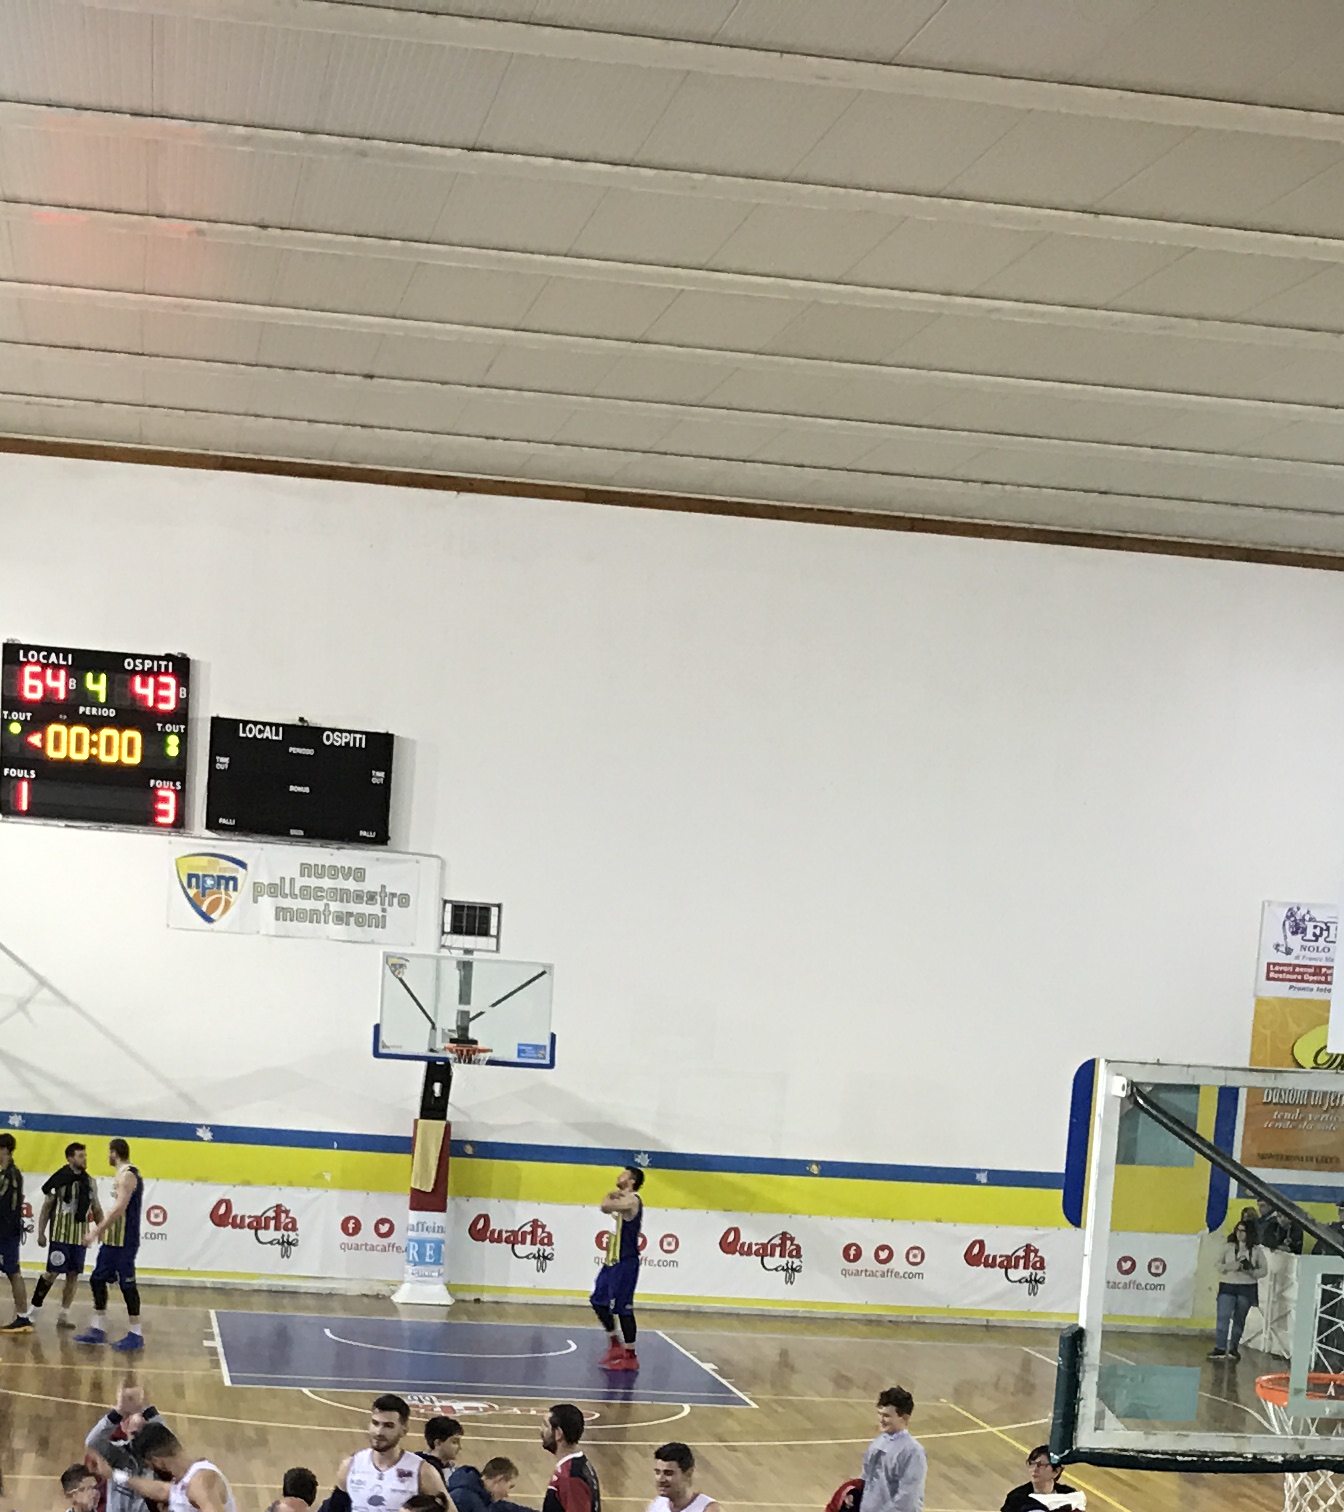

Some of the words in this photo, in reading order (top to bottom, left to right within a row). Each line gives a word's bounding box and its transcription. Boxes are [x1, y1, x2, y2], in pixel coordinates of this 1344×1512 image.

[19, 650, 72, 665] LOCALI
[124, 658, 173, 673] OSPITI
[22, 664, 67, 700] 64
[85, 671, 107, 703] 4
[133, 674, 177, 711] 43
[3, 711, 32, 721] T.OUT
[79, 706, 116, 717] PERIOD
[156, 723, 186, 733] T.OUT
[239, 723, 283, 740] LOCALI
[323, 731, 366, 748] OSPITI
[47, 723, 142, 765] 00:00
[4, 768, 36, 779] FOULS
[150, 780, 182, 790] FOULS
[19, 779, 29, 812] 1
[154, 789, 176, 825] 3
[300, 862, 366, 882] nuova
[187, 873, 238, 897] npm
[253, 877, 411, 908] pallacanestro
[275, 905, 387, 929] monteroni
[1300, 945, 1331, 953] NOLO
[209, 1198, 298, 1233] Quarta
[469, 1214, 554, 1247] Quarta
[719, 1226, 802, 1259] Quarta
[964, 1239, 1046, 1271] Quarta
[841, 1267, 925, 1280] quartacaffe.com
[1106, 1279, 1166, 1292] tacaffe.com
